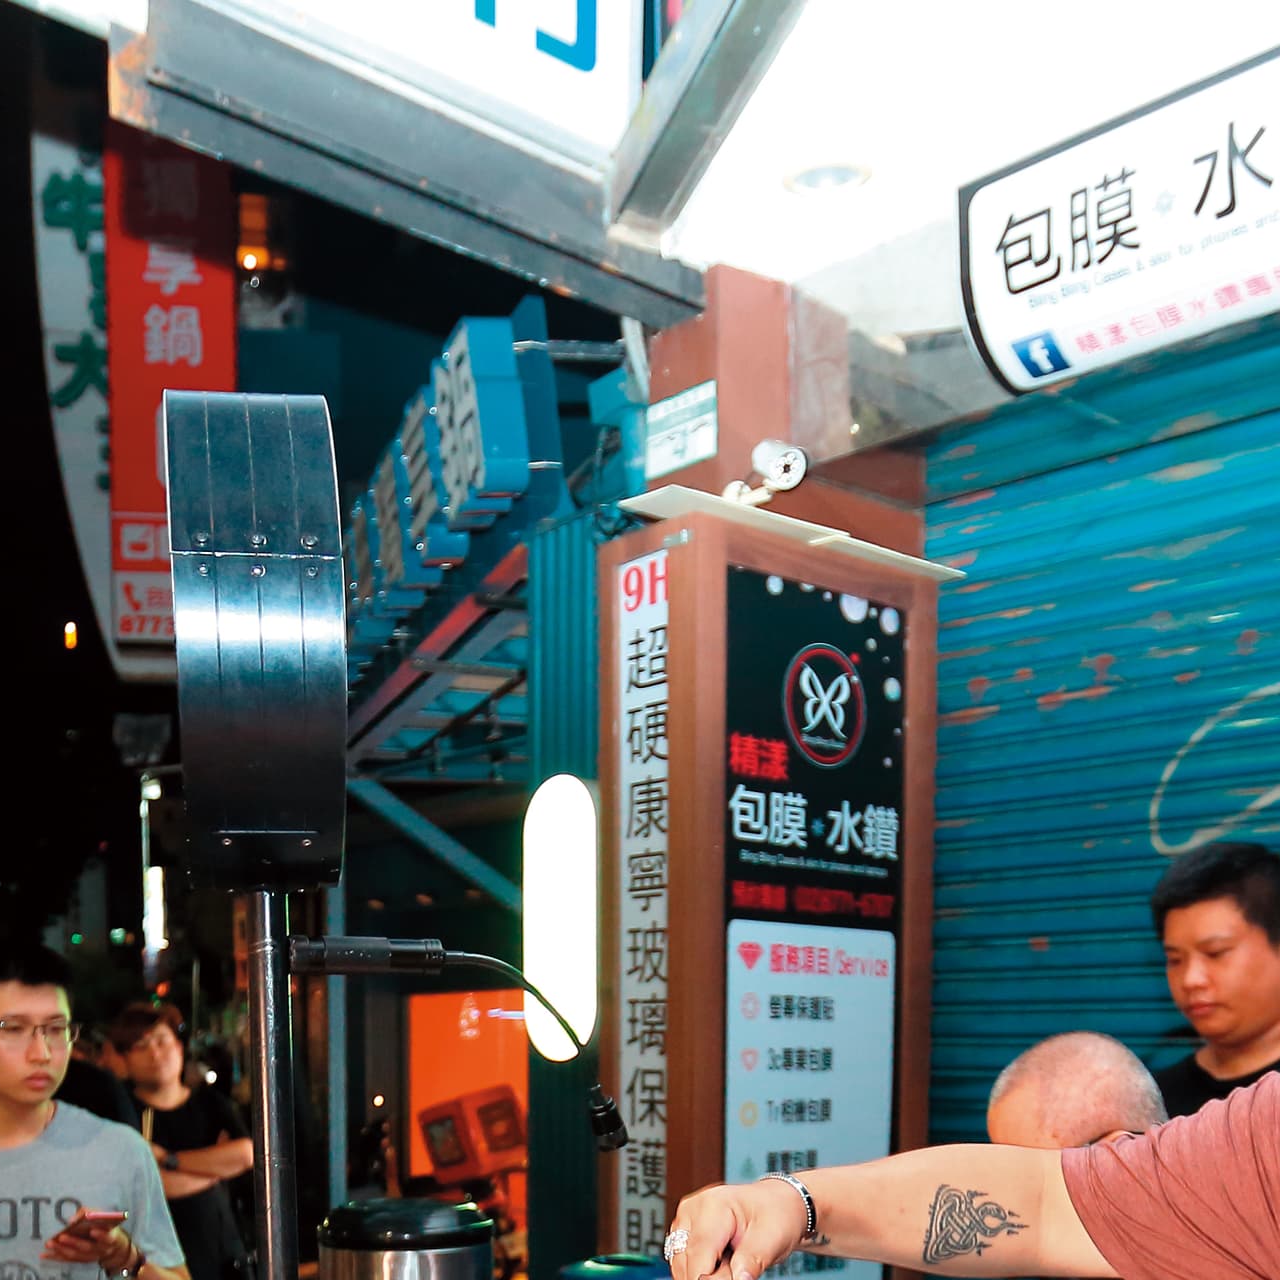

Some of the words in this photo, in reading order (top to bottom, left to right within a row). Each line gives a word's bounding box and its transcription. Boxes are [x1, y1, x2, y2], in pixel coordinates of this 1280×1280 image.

[995, 165, 1140, 295] 包膜
[728, 783, 808, 849] 包膜
[826, 799, 899, 861] 水鑽
